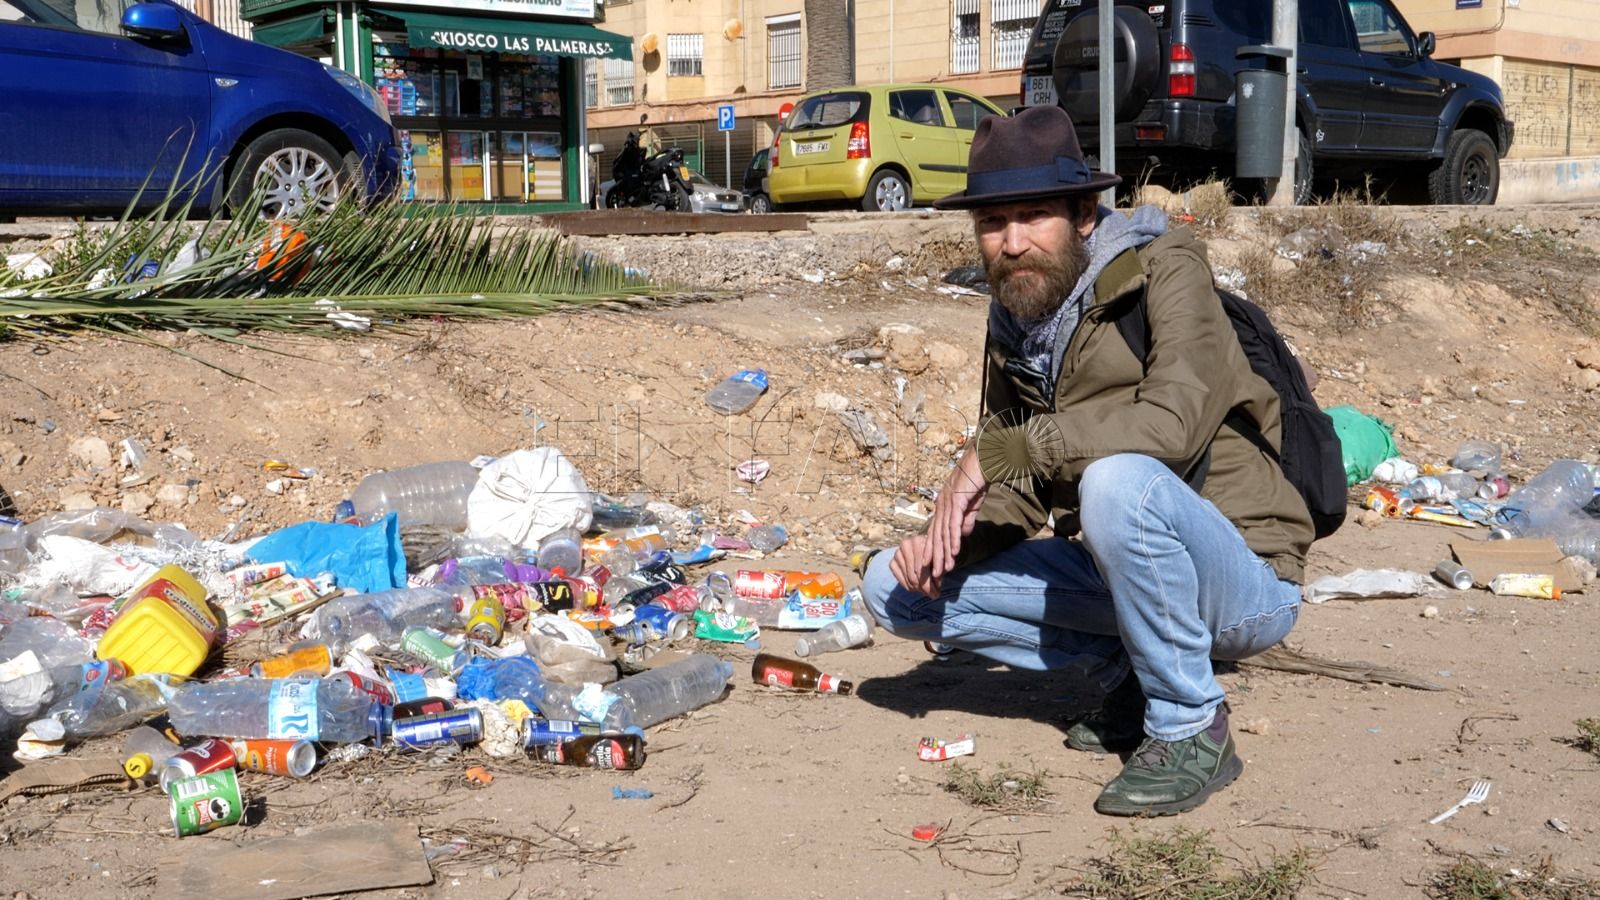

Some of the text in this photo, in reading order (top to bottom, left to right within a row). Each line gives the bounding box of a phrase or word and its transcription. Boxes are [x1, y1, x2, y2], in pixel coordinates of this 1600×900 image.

[440, 31, 604, 55] KIOSCO LAS PALMERAS
[1034, 92, 1051, 104] CRH
[721, 108, 731, 127] P
